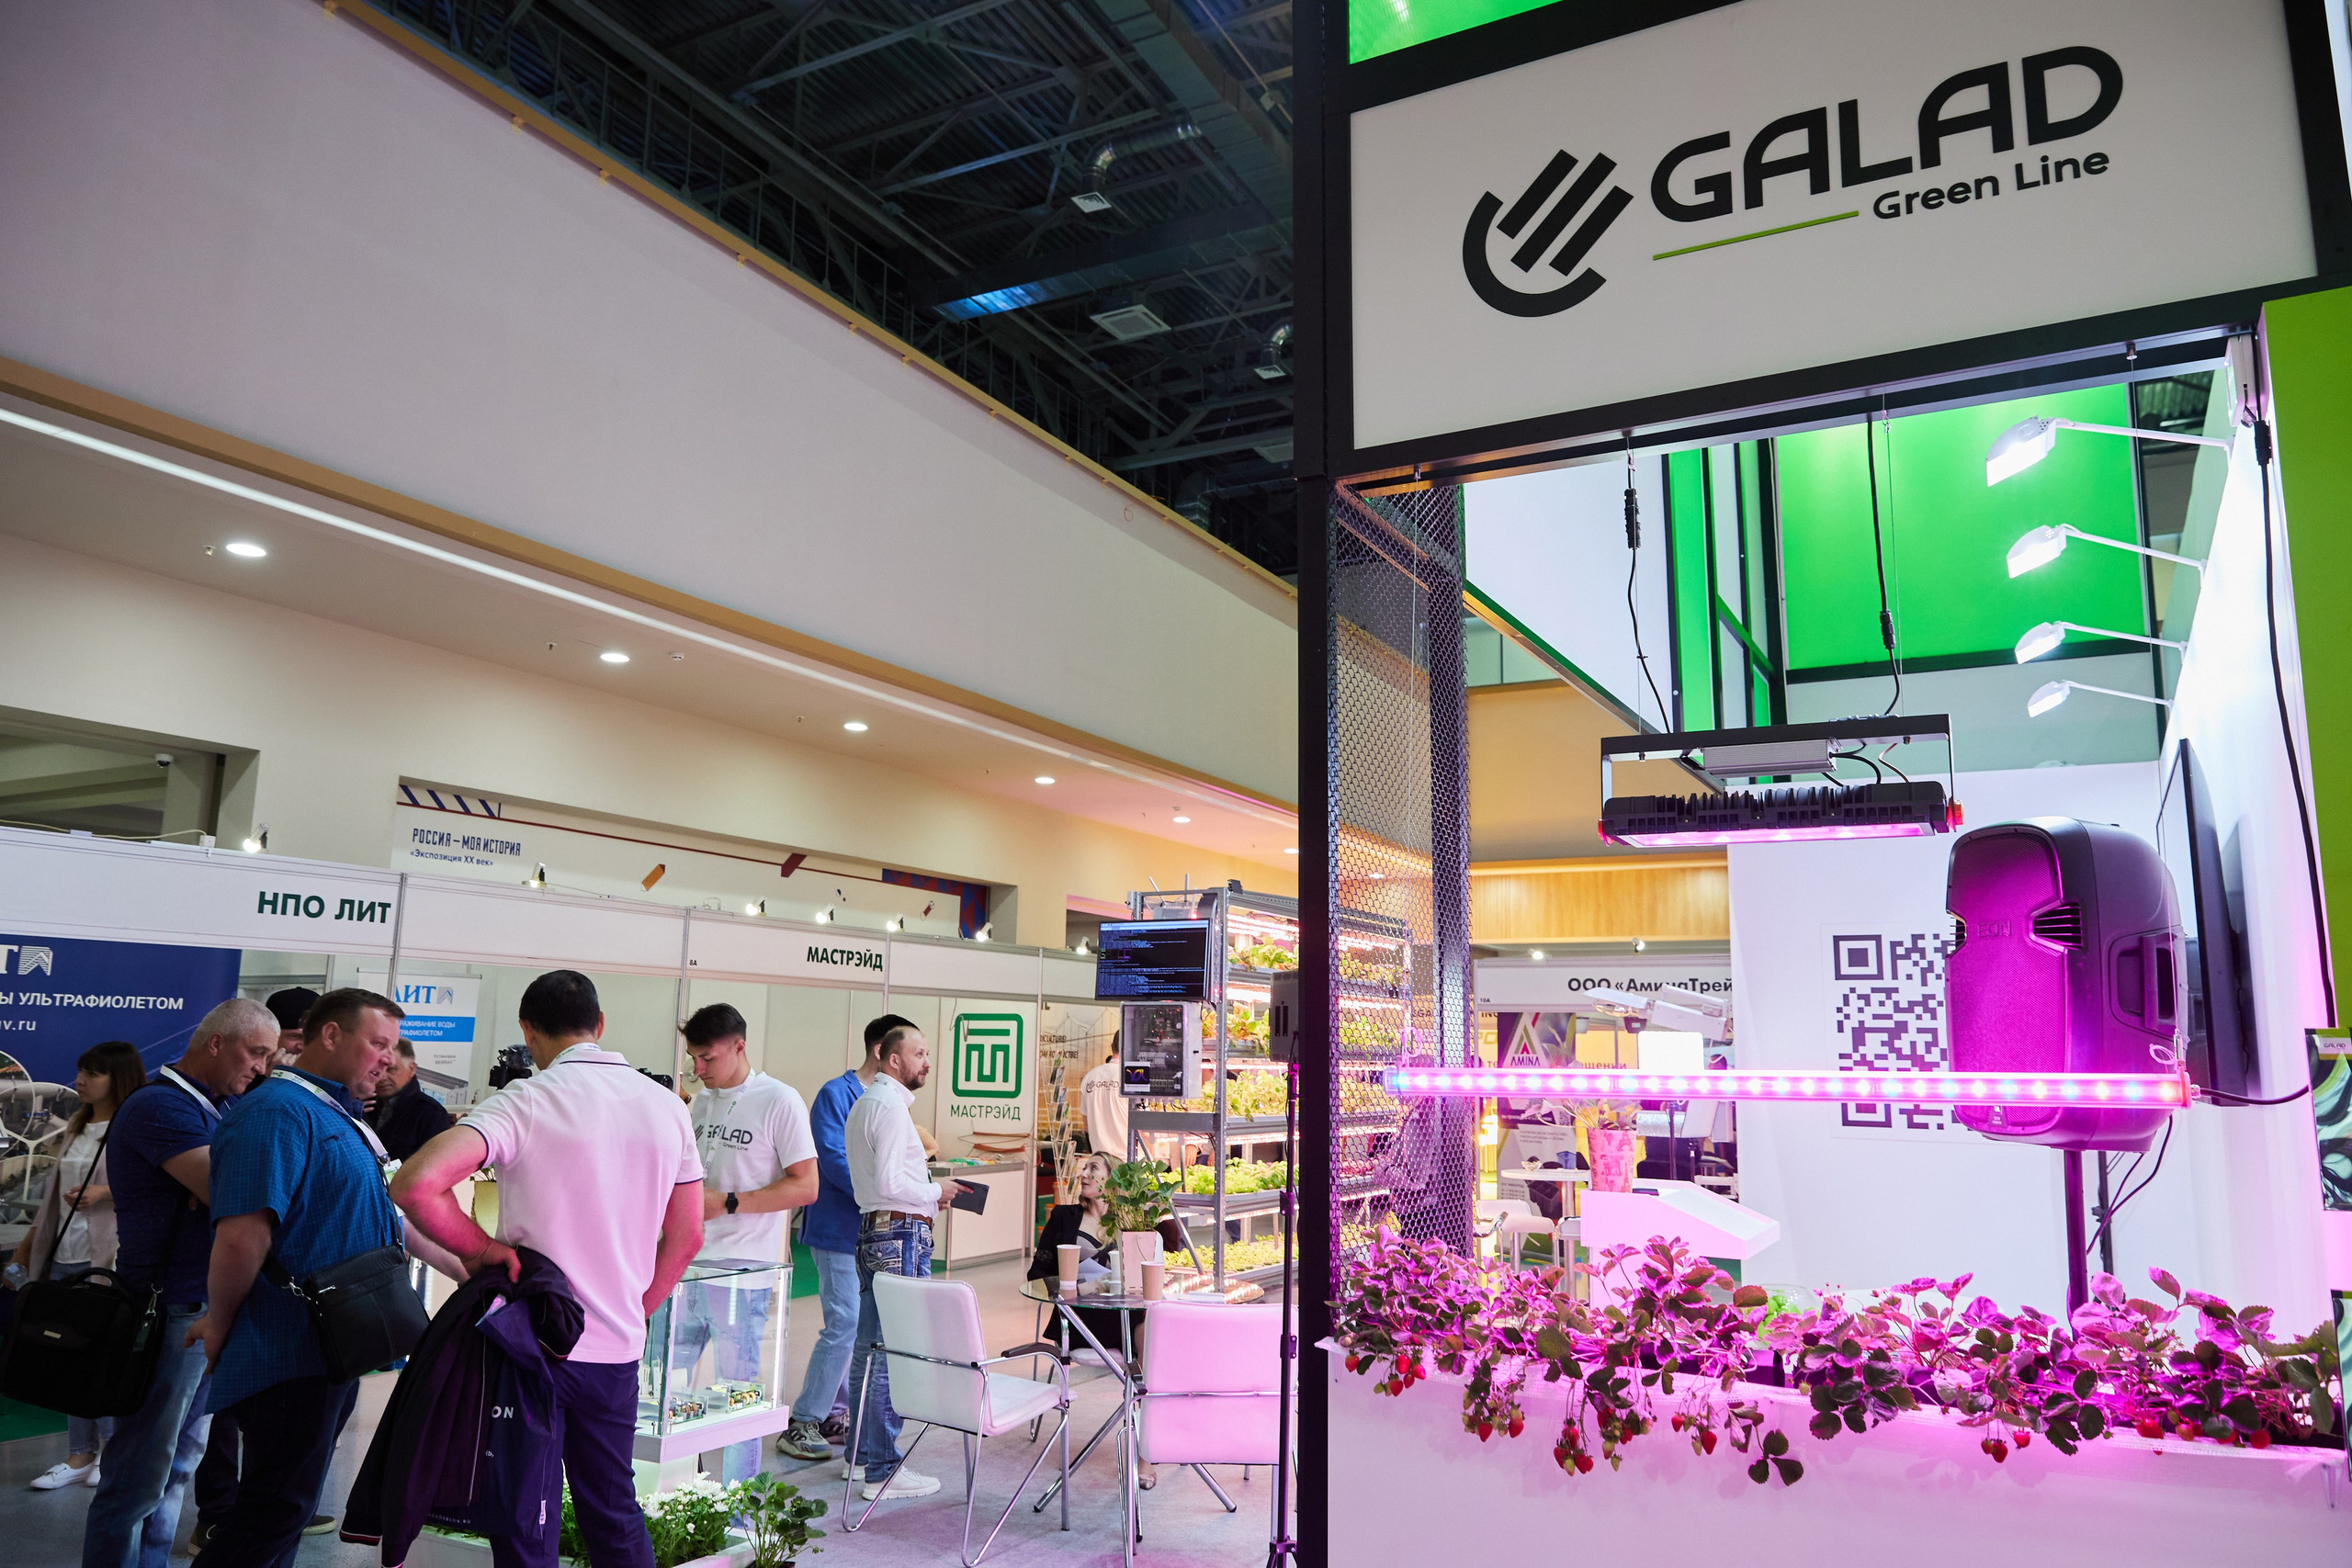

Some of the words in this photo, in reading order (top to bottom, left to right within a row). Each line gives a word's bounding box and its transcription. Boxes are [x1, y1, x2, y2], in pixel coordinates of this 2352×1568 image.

[1650, 45, 2124, 223] GALAD
[1872, 174, 1999, 220] Green
[2015, 151, 2111, 191] Line
[413, 828, 451, 847] РОССИЯ
[462, 835, 481, 852] МОЯ
[483, 838, 522, 856] ИСТОРИЯ
[410, 849, 462, 863] «Экспозиция
[257, 891, 325, 919] НПО
[334, 898, 391, 923] ЛИТ
[1977, 920, 2012, 938] EON
[807, 946, 883, 972] МАСТРЭЙД
[1567, 977, 1611, 992] ООО
[19, 992, 184, 1010] УЛЬТРАФИОЛЕТОМ
[1510, 1055, 1541, 1066] AMINA
[950, 1104, 1021, 1121] МАСТРЭЙД
